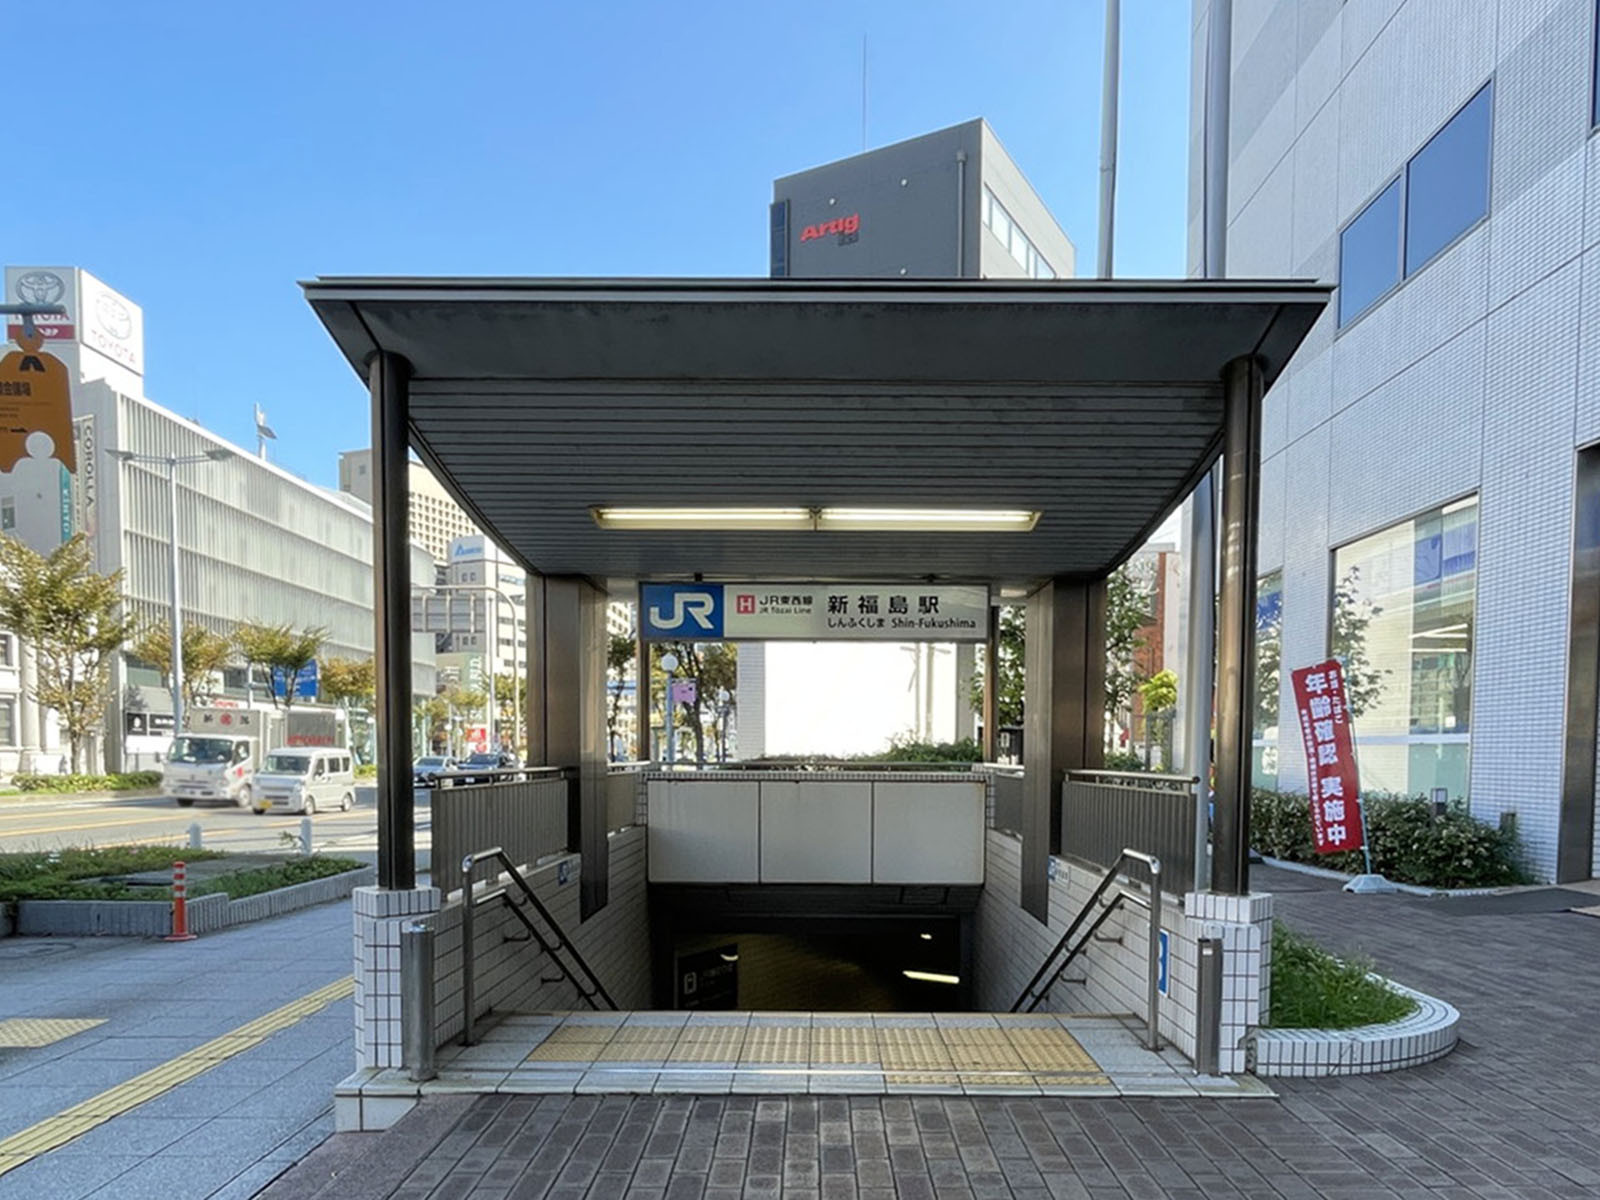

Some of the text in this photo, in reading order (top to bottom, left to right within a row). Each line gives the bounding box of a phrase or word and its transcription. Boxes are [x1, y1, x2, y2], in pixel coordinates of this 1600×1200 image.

[84, 425, 94, 507] COROLLA
[649, 592, 715, 630] JR
[827, 595, 940, 615] 新福島駅
[827, 617, 977, 629] しんふくしま Shin-Fukushima
